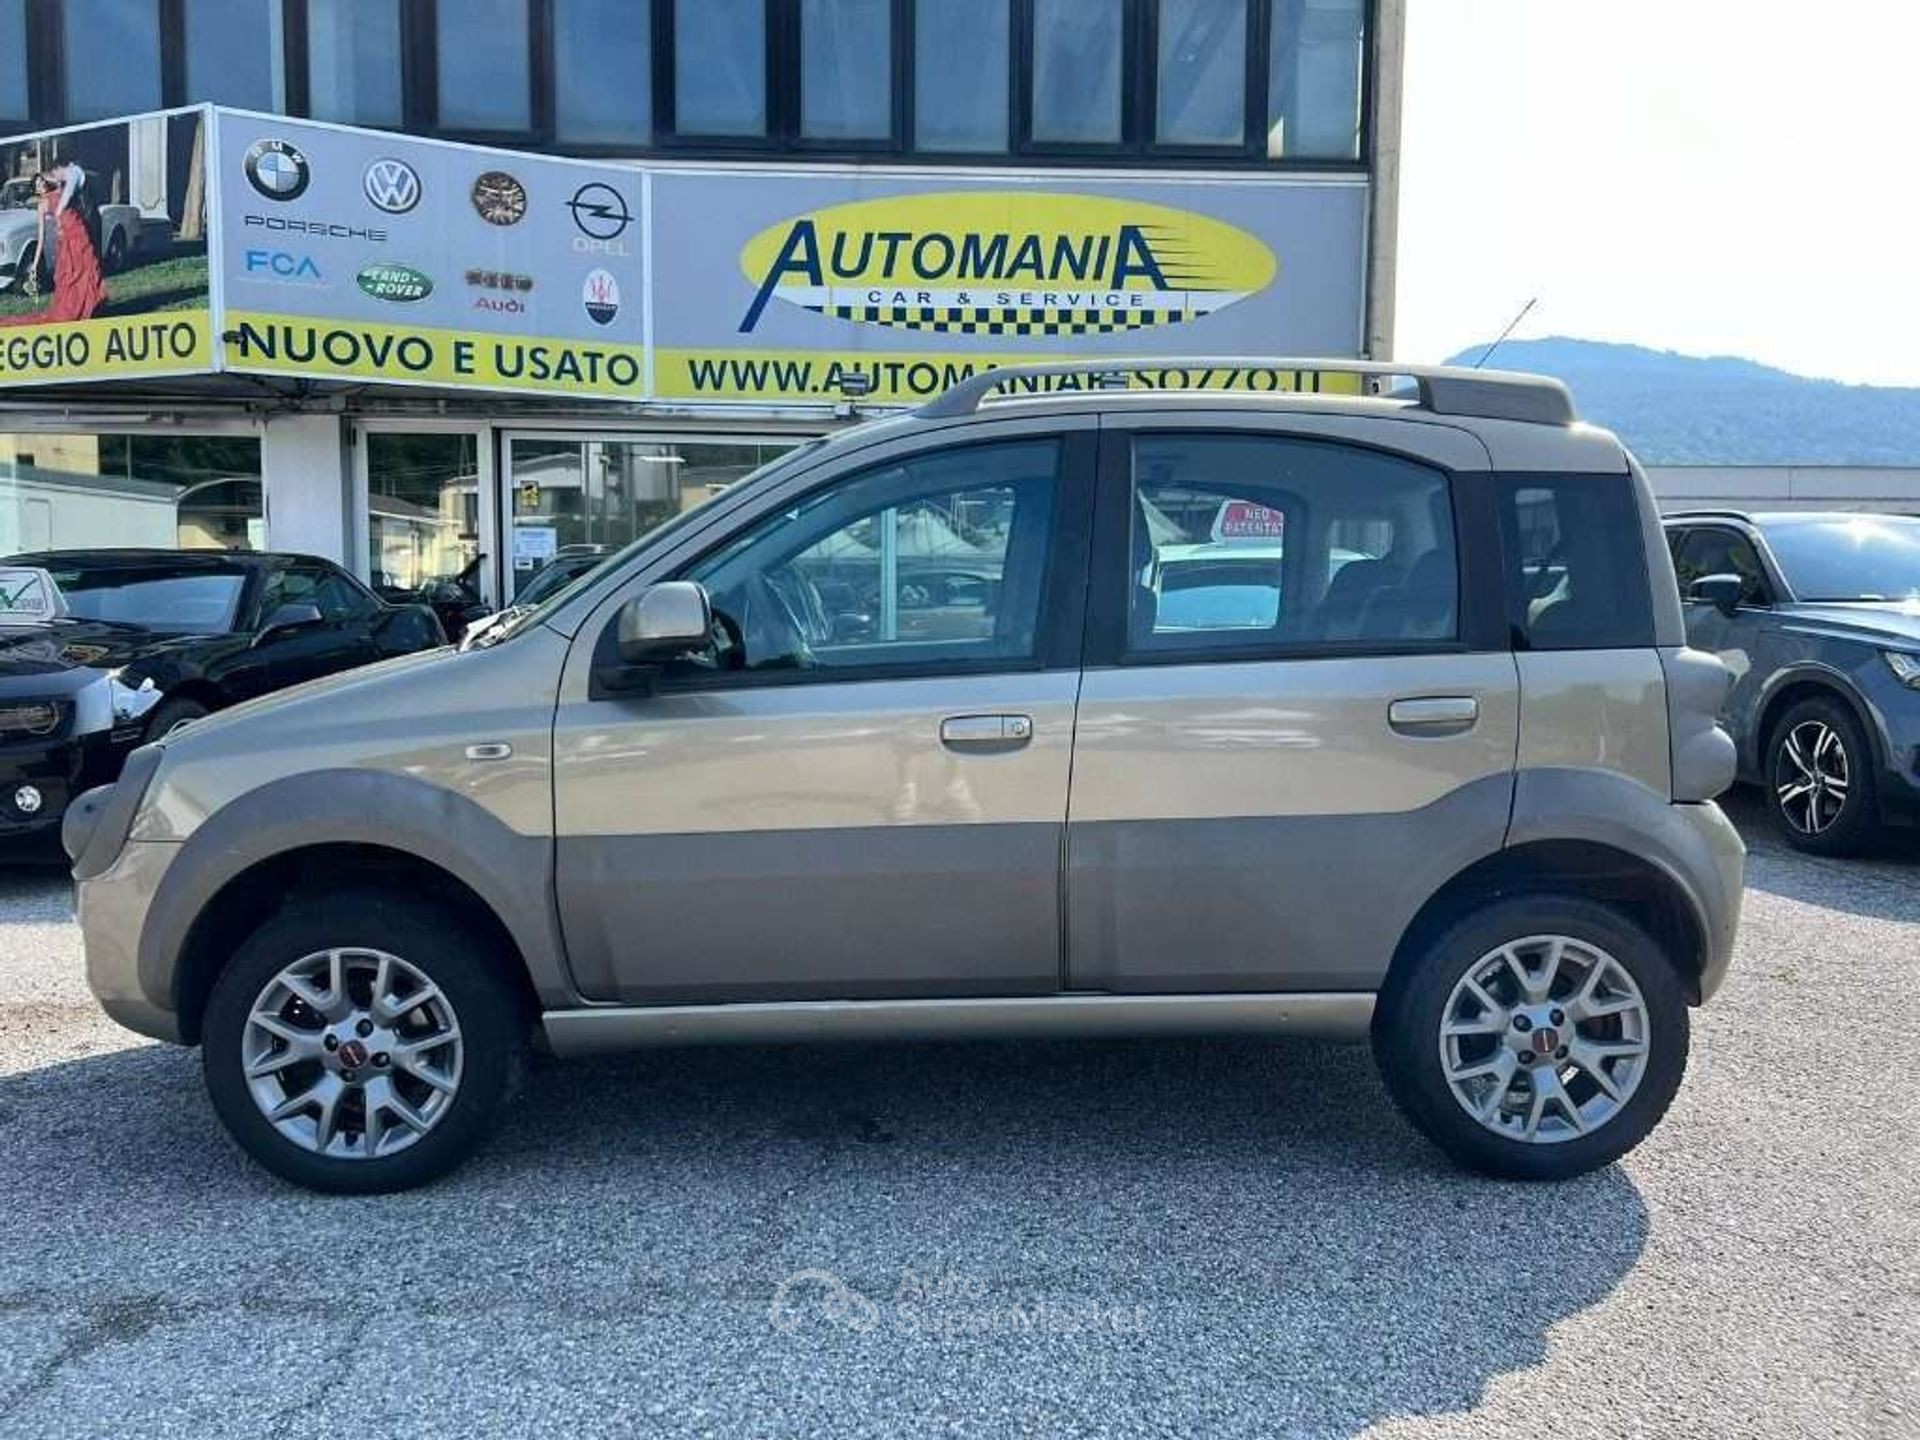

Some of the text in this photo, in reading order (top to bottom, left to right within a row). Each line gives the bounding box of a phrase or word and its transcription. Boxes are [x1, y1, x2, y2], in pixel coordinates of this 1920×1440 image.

[244, 215, 388, 241] PORSCHE
[572, 237, 630, 257] OPEL
[246, 250, 321, 279] FCA
[738, 220, 1168, 333] AUTOMANIA
[867, 290, 1144, 307] CAR & SERVICE
[105, 322, 197, 363] AUTO
[239, 322, 639, 386] NUOVO E USATO
